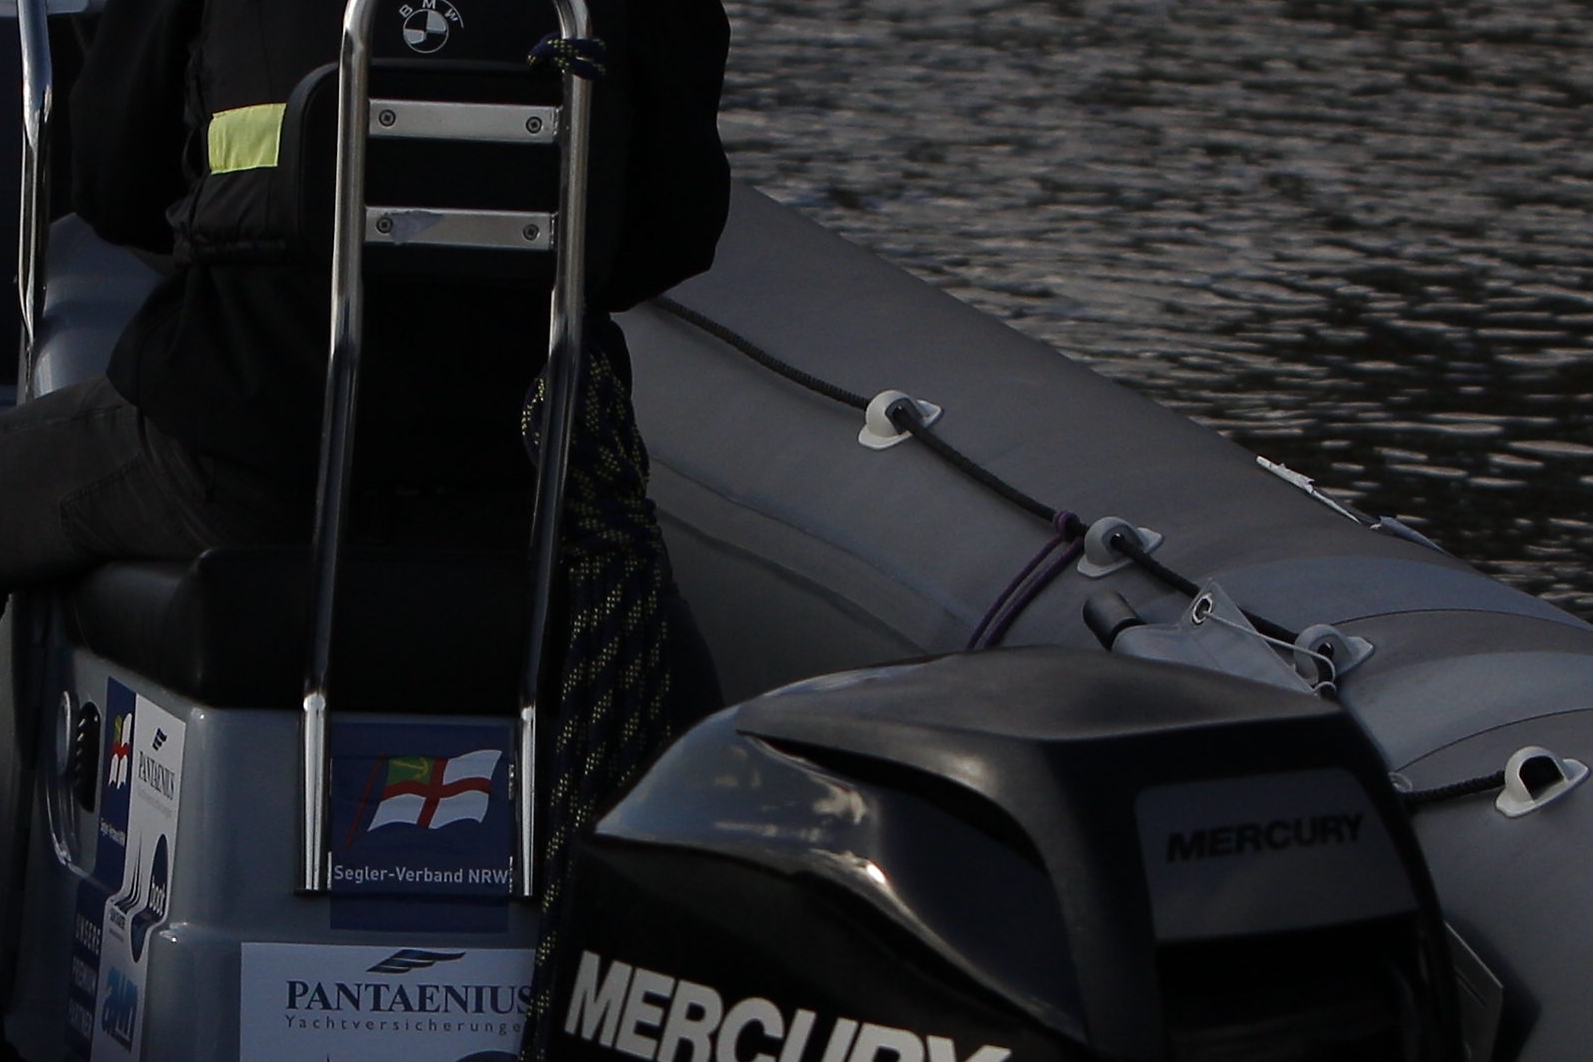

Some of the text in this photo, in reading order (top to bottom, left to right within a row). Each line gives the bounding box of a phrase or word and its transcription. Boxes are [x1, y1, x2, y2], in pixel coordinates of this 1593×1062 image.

[1167, 814, 1363, 863] MERCURY
[333, 864, 508, 885] Segler-Verband NRW
[286, 980, 533, 1015] PANTAENIUS
[285, 1014, 522, 1036] Yachtversicherunge
